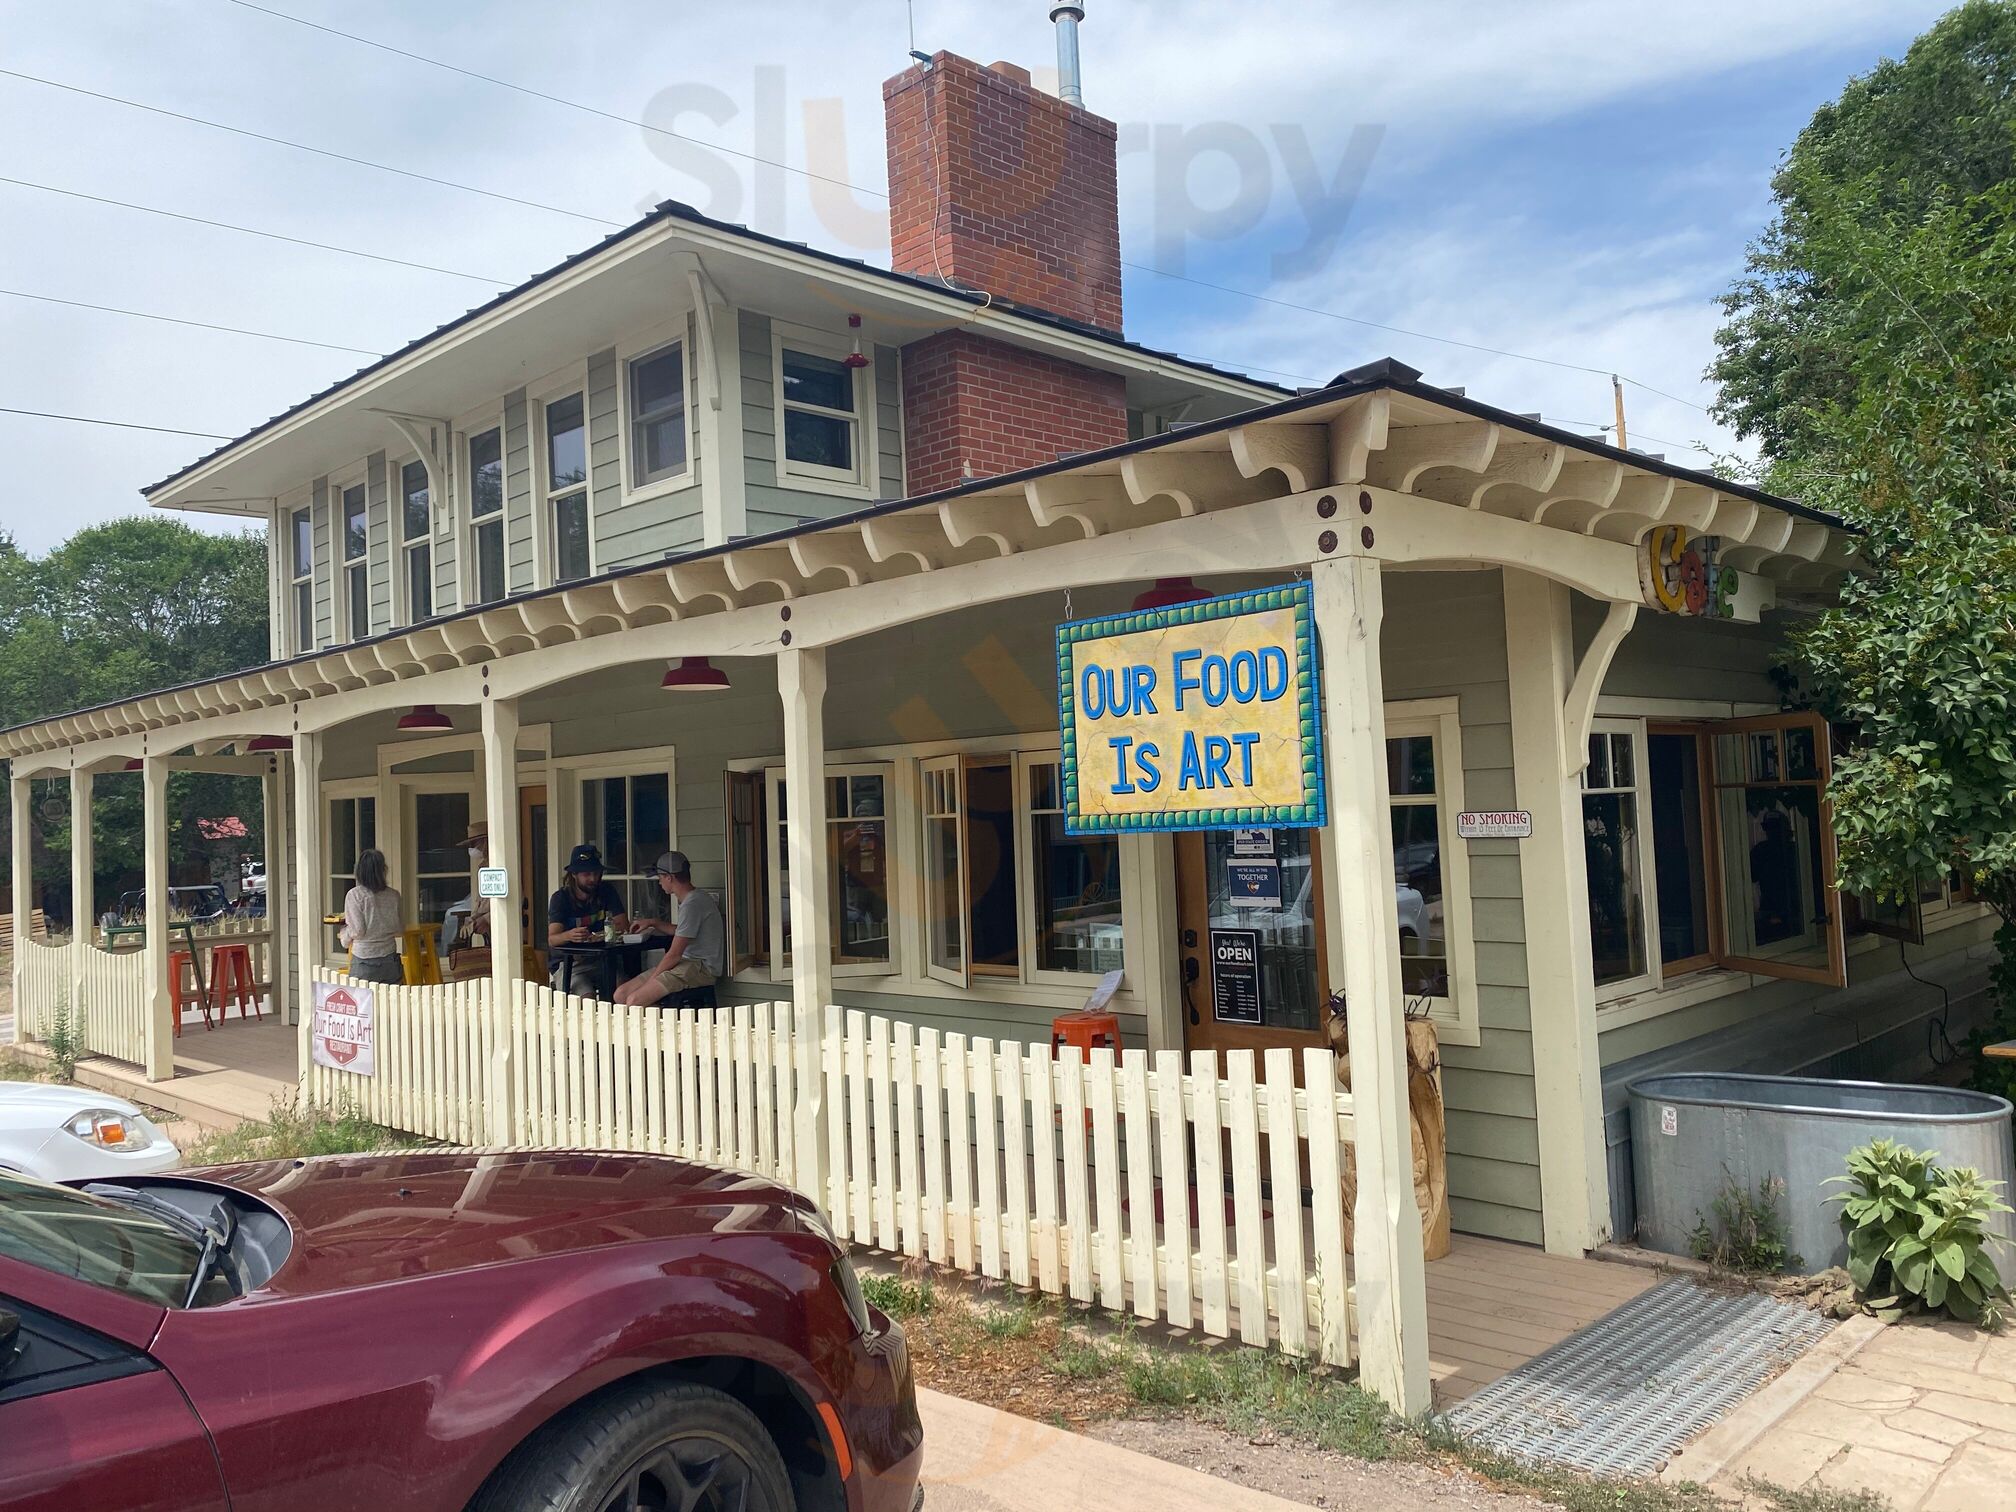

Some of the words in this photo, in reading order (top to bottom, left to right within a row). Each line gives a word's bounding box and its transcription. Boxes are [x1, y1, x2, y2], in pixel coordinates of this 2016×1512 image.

[1081, 663, 1158, 720] OUR
[1171, 645, 1289, 712] FOOD
[1108, 735, 1162, 795] IS
[1178, 730, 1261, 791] ART
[1461, 814, 1476, 825] NO
[1480, 813, 1527, 825] SMOKING
[1217, 947, 1252, 961] OPEN
[314, 1011, 326, 1034] Our
[328, 1014, 345, 1038] Food
[357, 1019, 372, 1044] Art
